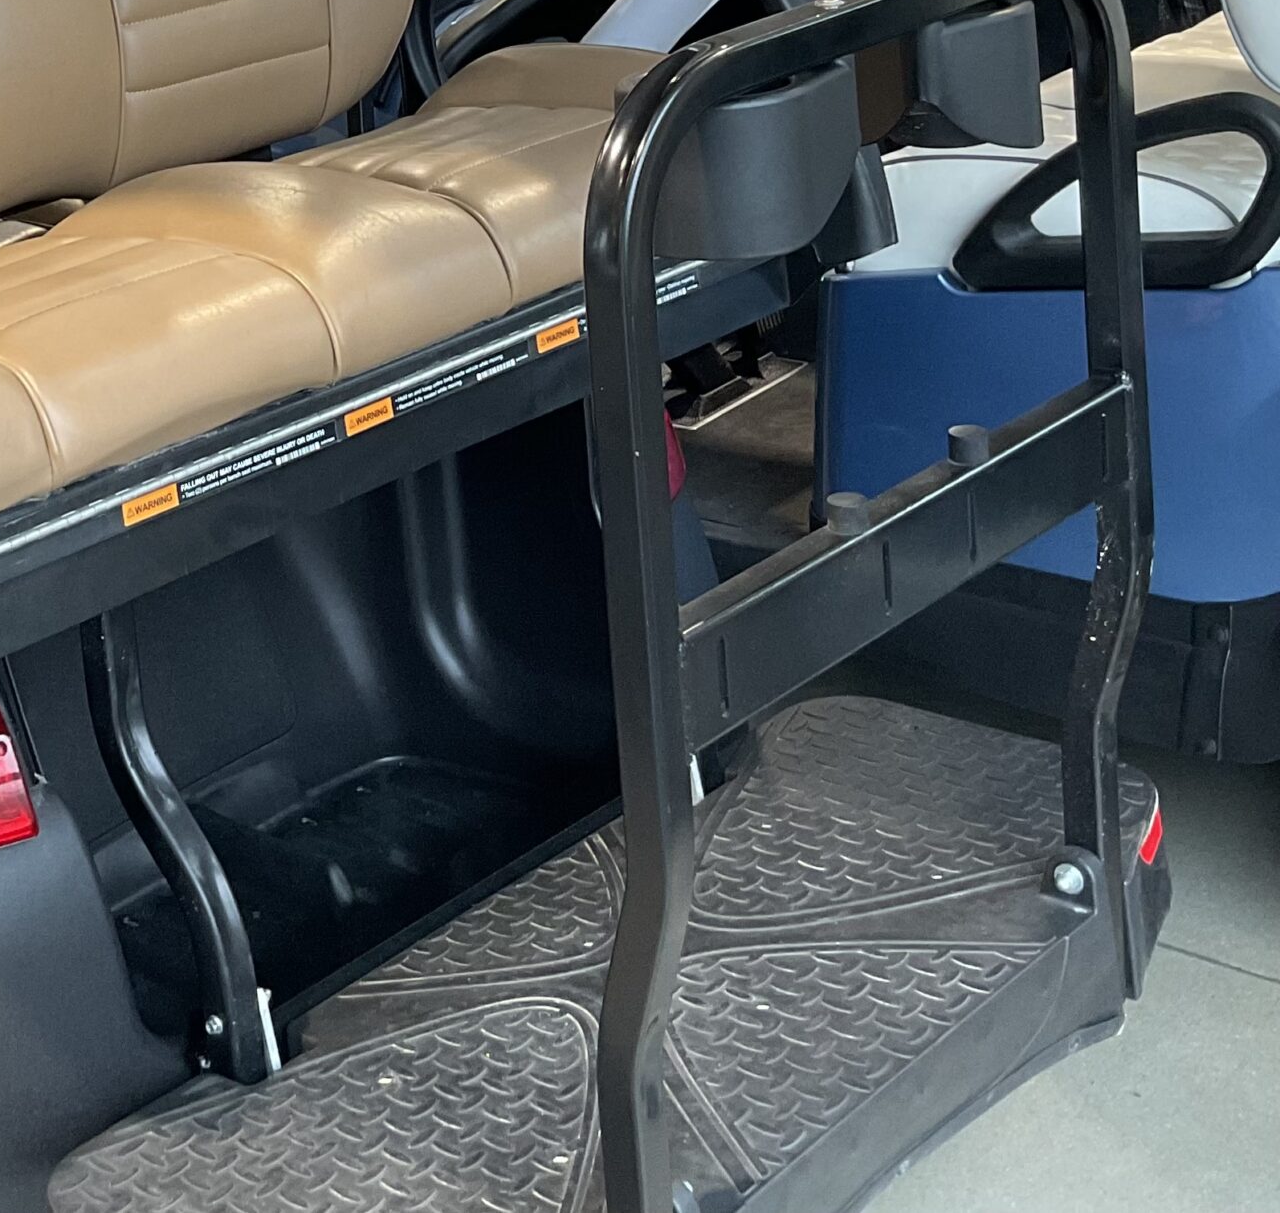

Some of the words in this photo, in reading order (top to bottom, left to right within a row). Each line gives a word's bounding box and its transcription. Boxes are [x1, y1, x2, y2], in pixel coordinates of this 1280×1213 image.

[545, 326, 575, 343] WARNING
[355, 405, 389, 425] WARNING
[180, 476, 206, 492] FALLING
[206, 470, 219, 482] OUT
[305, 428, 325, 442] DEATH
[134, 492, 173, 515] WARNING
